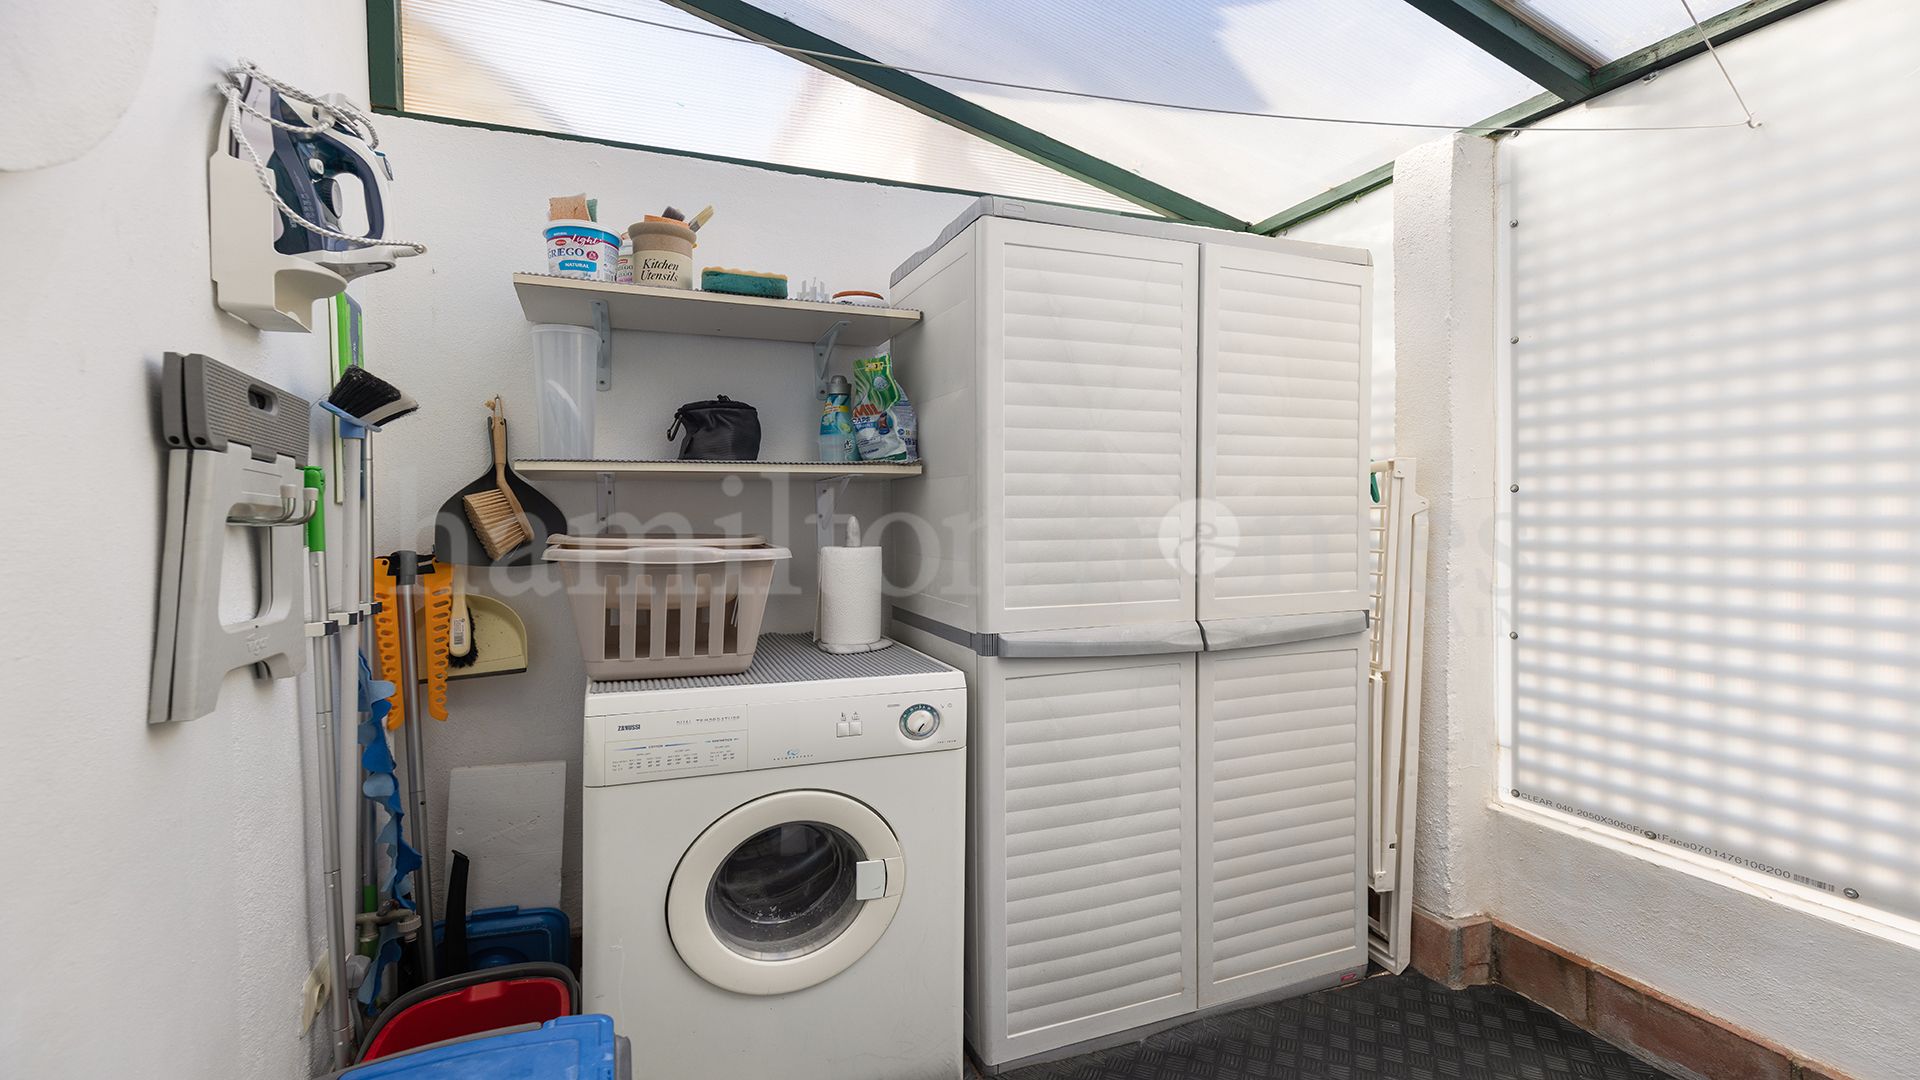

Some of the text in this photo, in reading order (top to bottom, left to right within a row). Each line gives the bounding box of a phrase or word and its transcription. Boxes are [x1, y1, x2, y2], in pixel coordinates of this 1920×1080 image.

[642, 258, 679, 271] Kitchen
[640, 269, 679, 282] Utensils
[617, 723, 641, 731] ZANUSSI
[1520, 792, 1553, 807] CLEAR
[1555, 802, 1574, 813] 040
